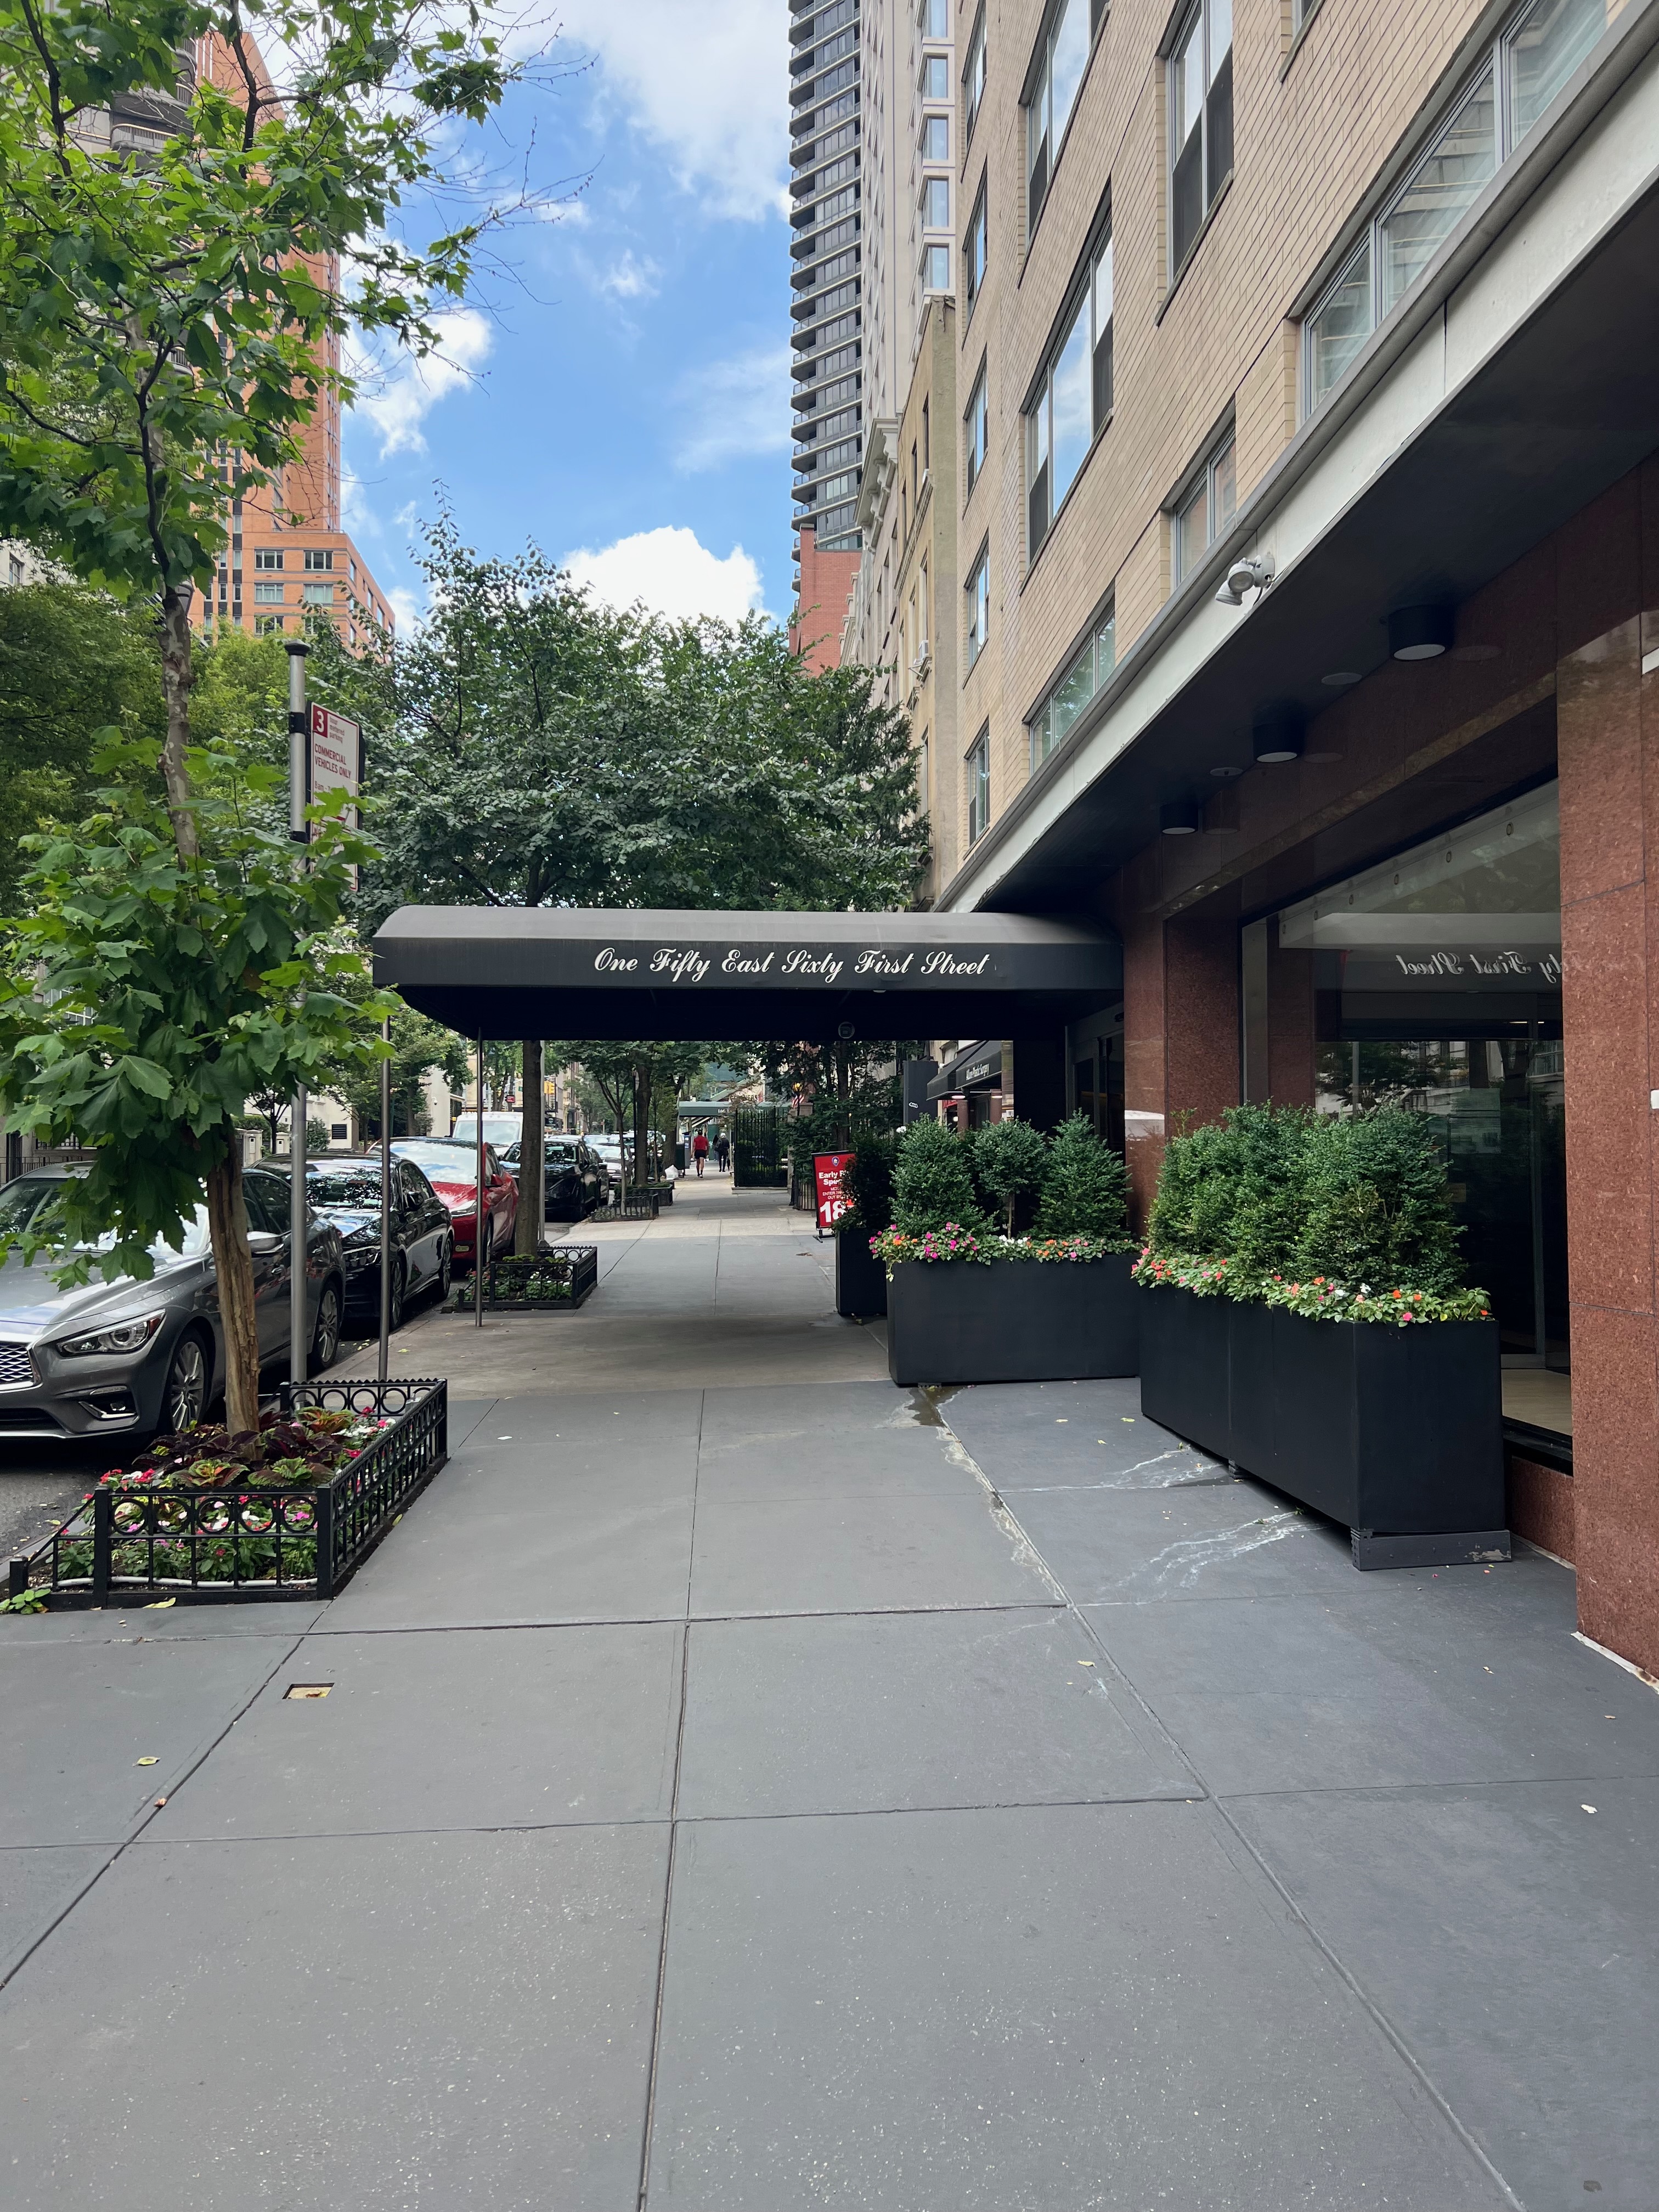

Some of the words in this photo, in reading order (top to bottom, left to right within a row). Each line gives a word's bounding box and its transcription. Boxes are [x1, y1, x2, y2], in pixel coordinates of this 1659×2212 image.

[316, 710, 325, 733] 3
[315, 743, 346, 765] COMMERCIAL
[314, 755, 338, 774] VEHICLES
[339, 766, 352, 779] ONLY
[594, 947, 638, 971] One
[650, 948, 711, 982] Fifty
[721, 949, 775, 973] East
[781, 949, 844, 983] Sixty
[854, 950, 915, 974] First
[921, 951, 990, 974] Street
[819, 1171, 838, 1179] Early
